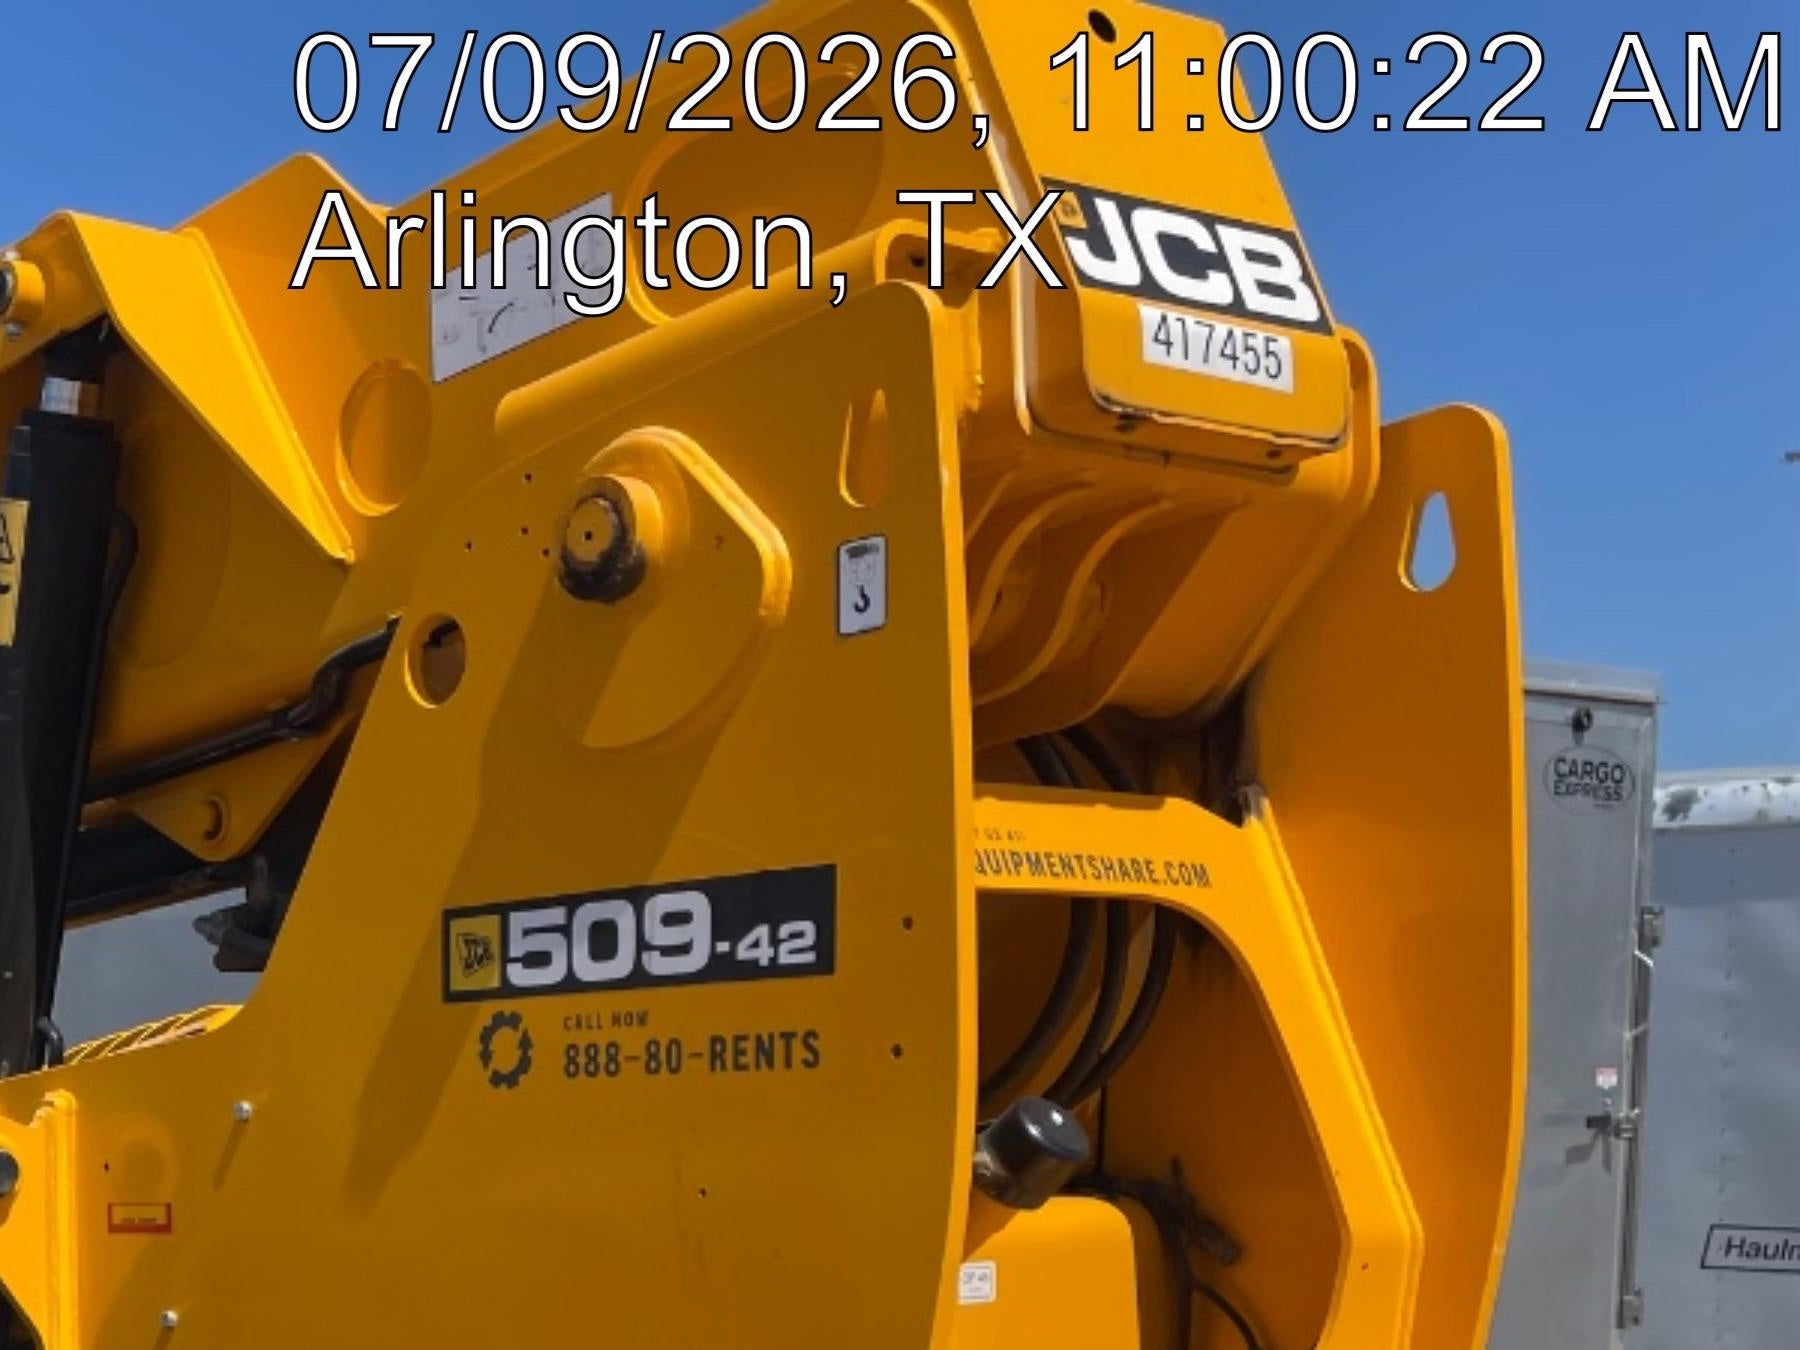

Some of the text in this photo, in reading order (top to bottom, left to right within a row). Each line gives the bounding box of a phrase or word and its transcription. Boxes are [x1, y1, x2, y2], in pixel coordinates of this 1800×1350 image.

[1065, 197, 1321, 323] JCB
[1152, 313, 1283, 380] 417455
[1553, 756, 1626, 784] CARGO
[505, 889, 818, 988] 509-42
[563, 1010, 650, 1032] CALL NOW
[563, 1029, 821, 1079] 888-80-RENTS
